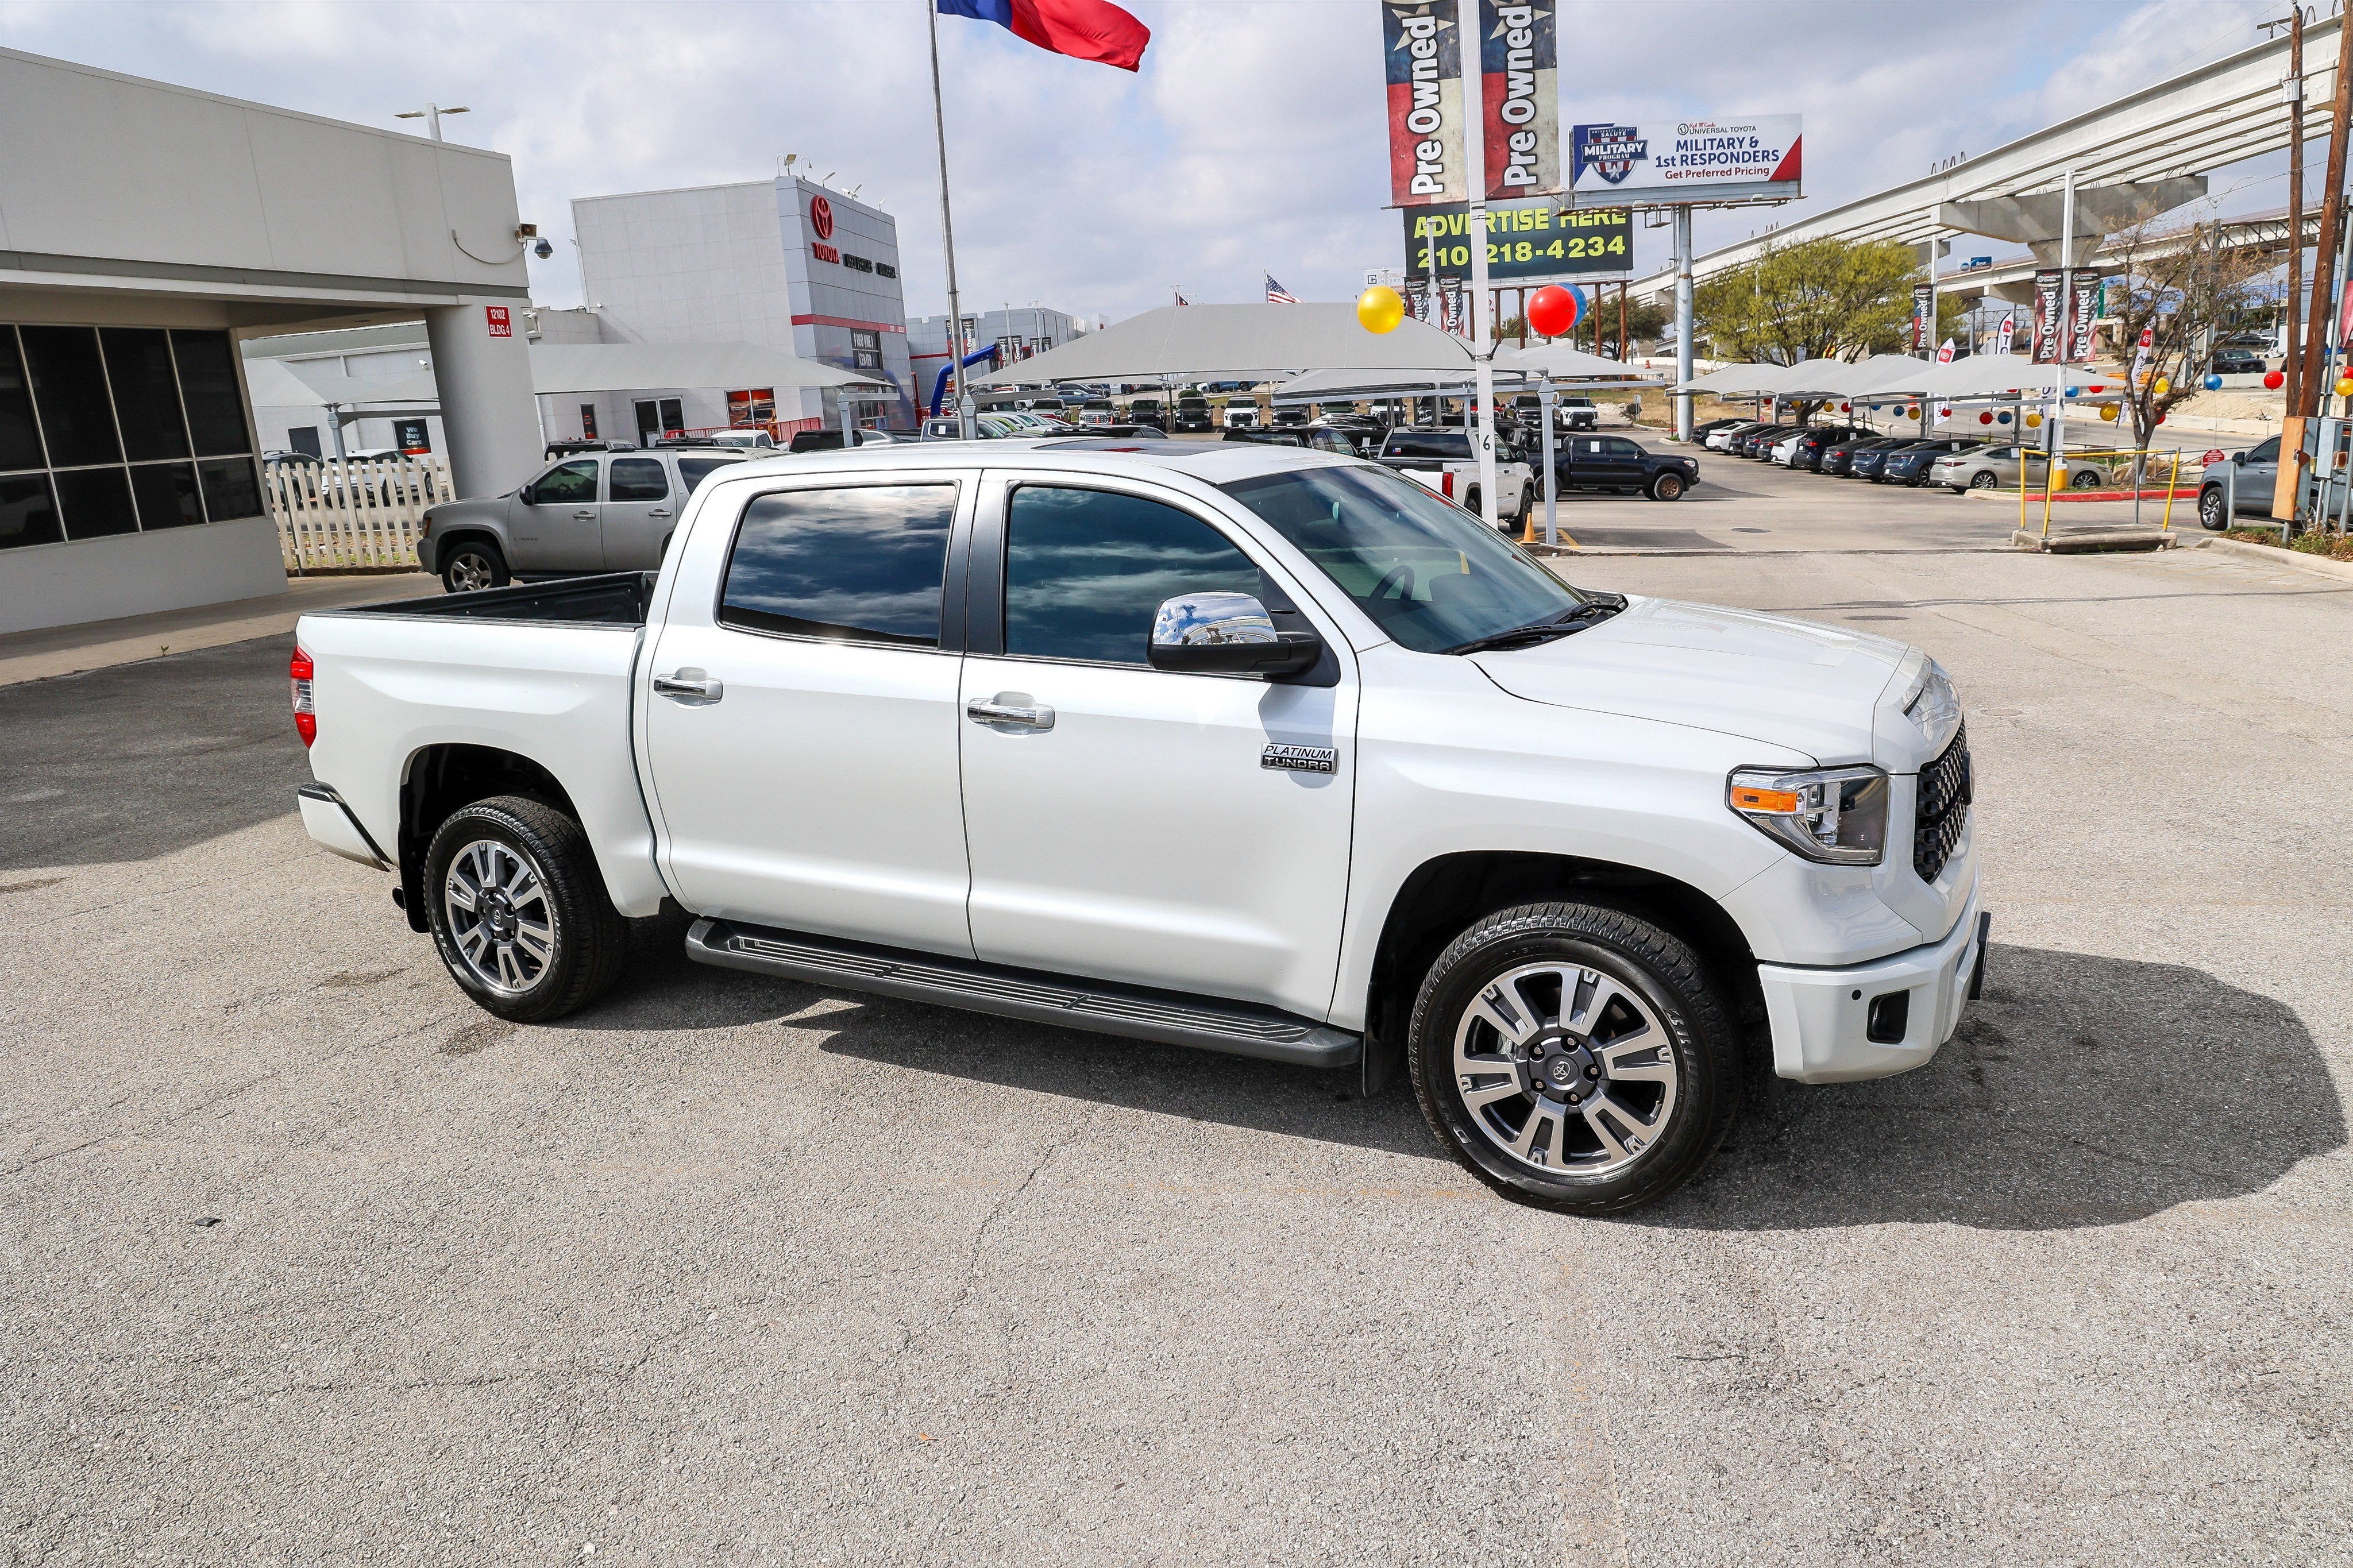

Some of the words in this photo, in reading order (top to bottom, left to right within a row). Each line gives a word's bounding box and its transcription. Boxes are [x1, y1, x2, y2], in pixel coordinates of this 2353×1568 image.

[1402, 16, 1441, 133] Owned
[1498, 5, 1536, 124] Owned
[1689, 126, 1729, 134] UNIVERSAL
[1584, 142, 1645, 156] MILITARY
[1676, 136, 1746, 152] MILITARY
[1749, 136, 1760, 148] &
[1411, 139, 1444, 195] Pre
[1504, 131, 1537, 186] Pre
[1599, 153, 1630, 161] PROGRAM
[1655, 155, 1676, 168] 1st
[1680, 149, 1780, 167] RESPONDERS
[1665, 170, 1683, 179] Get
[1685, 167, 1732, 178] Preferred
[1735, 166, 1770, 177] Pricing
[815, 242, 840, 264] TOYOTA
[490, 308, 506, 319] 12102
[1411, 293, 1424, 322] wned
[1445, 291, 1457, 327] Owned
[1918, 300, 1928, 331] Owned
[2040, 290, 2056, 335] Owned
[2074, 289, 2090, 333] Owned
[1918, 333, 1927, 347] Pre
[2040, 337, 2054, 359] Pre
[2074, 335, 2088, 358] Pre
[1483, 433, 1491, 451] 6
[1264, 745, 1332, 759] PLATINUM
[1264, 756, 1330, 770] TUNDRA
